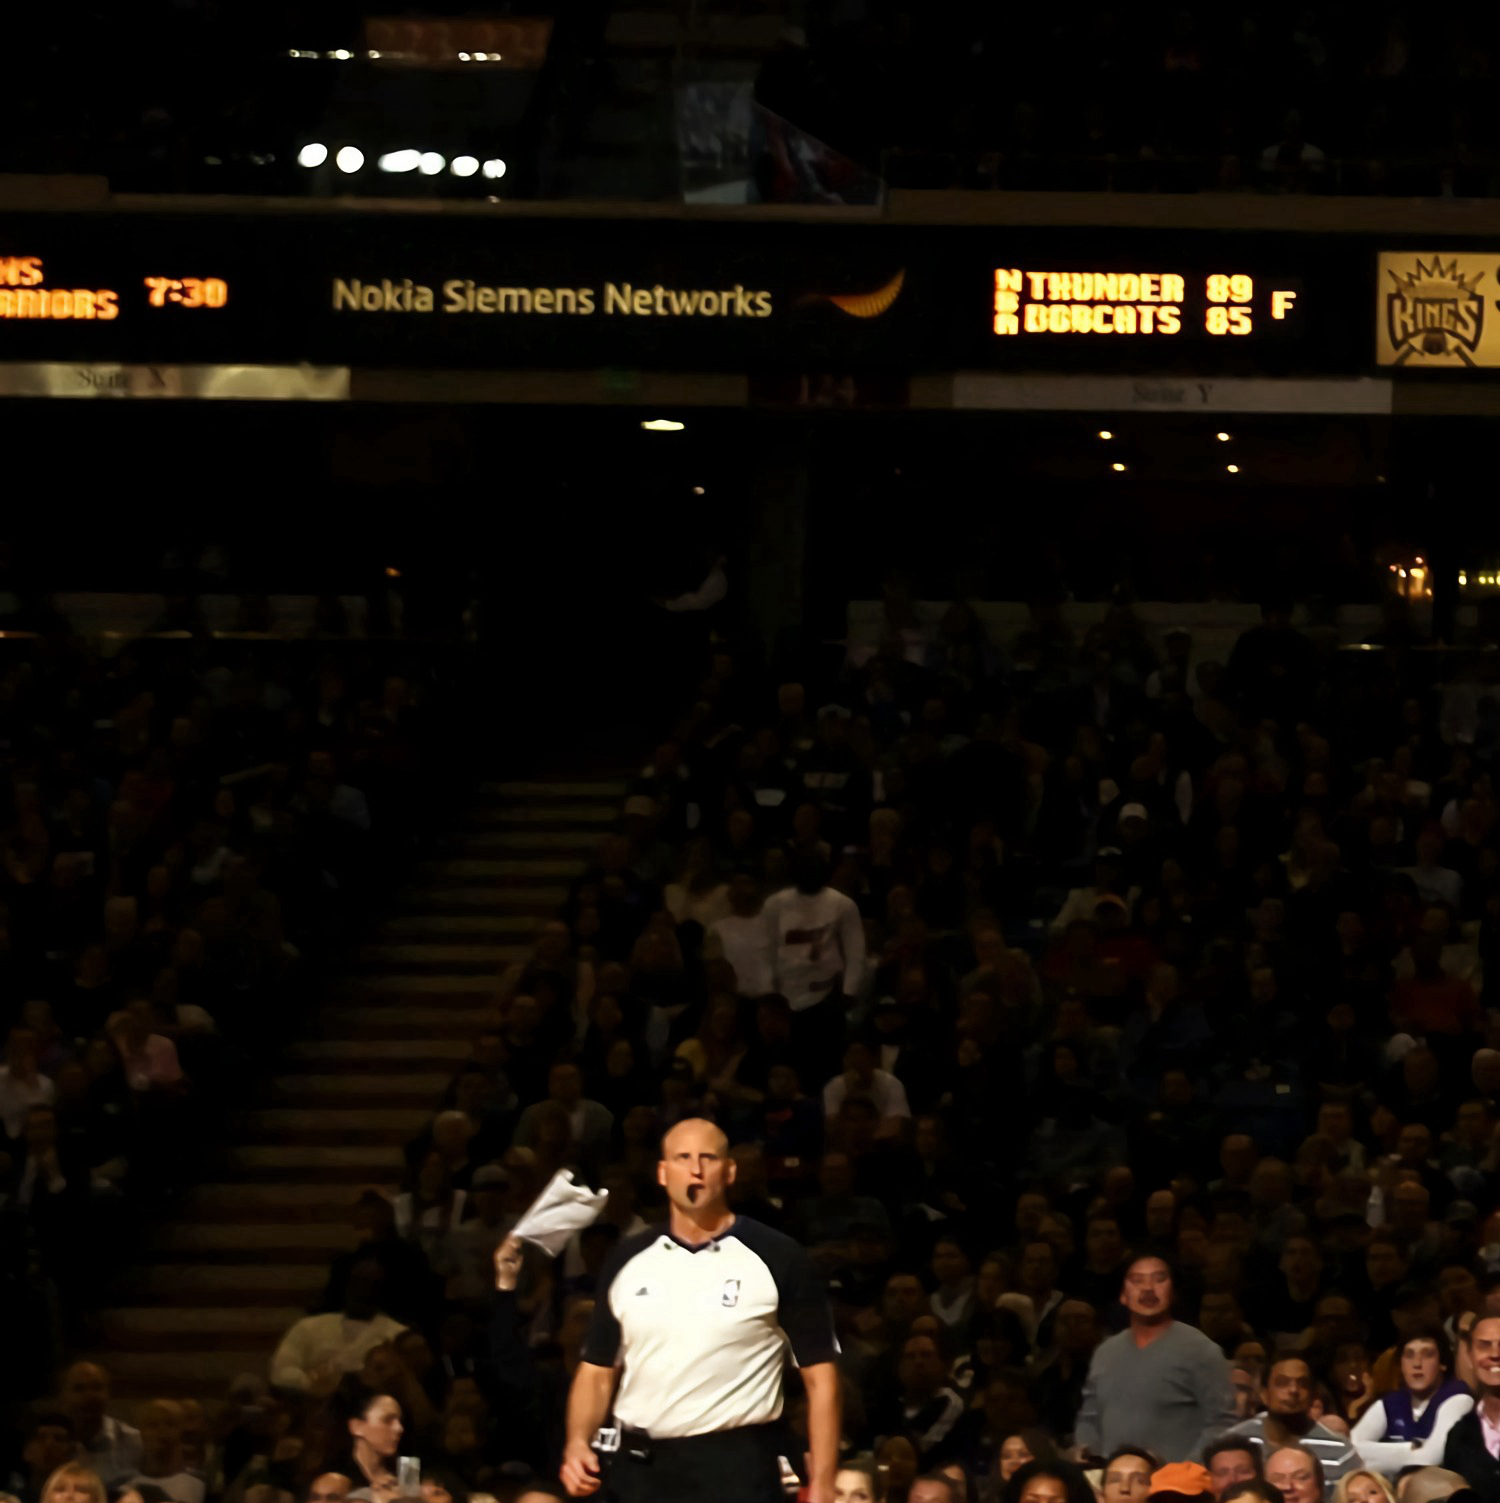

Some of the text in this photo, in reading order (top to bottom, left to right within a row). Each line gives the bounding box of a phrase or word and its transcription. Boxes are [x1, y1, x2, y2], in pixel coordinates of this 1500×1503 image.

[143, 276, 228, 308] 7:30
[332, 277, 773, 319] Nokia Siemens Networks
[1026, 272, 1253, 303] THUNDER 89
[1024, 304, 1253, 335] BOBCATS 85
[1272, 291, 1297, 320] F
[1391, 297, 1482, 337] KINGS
